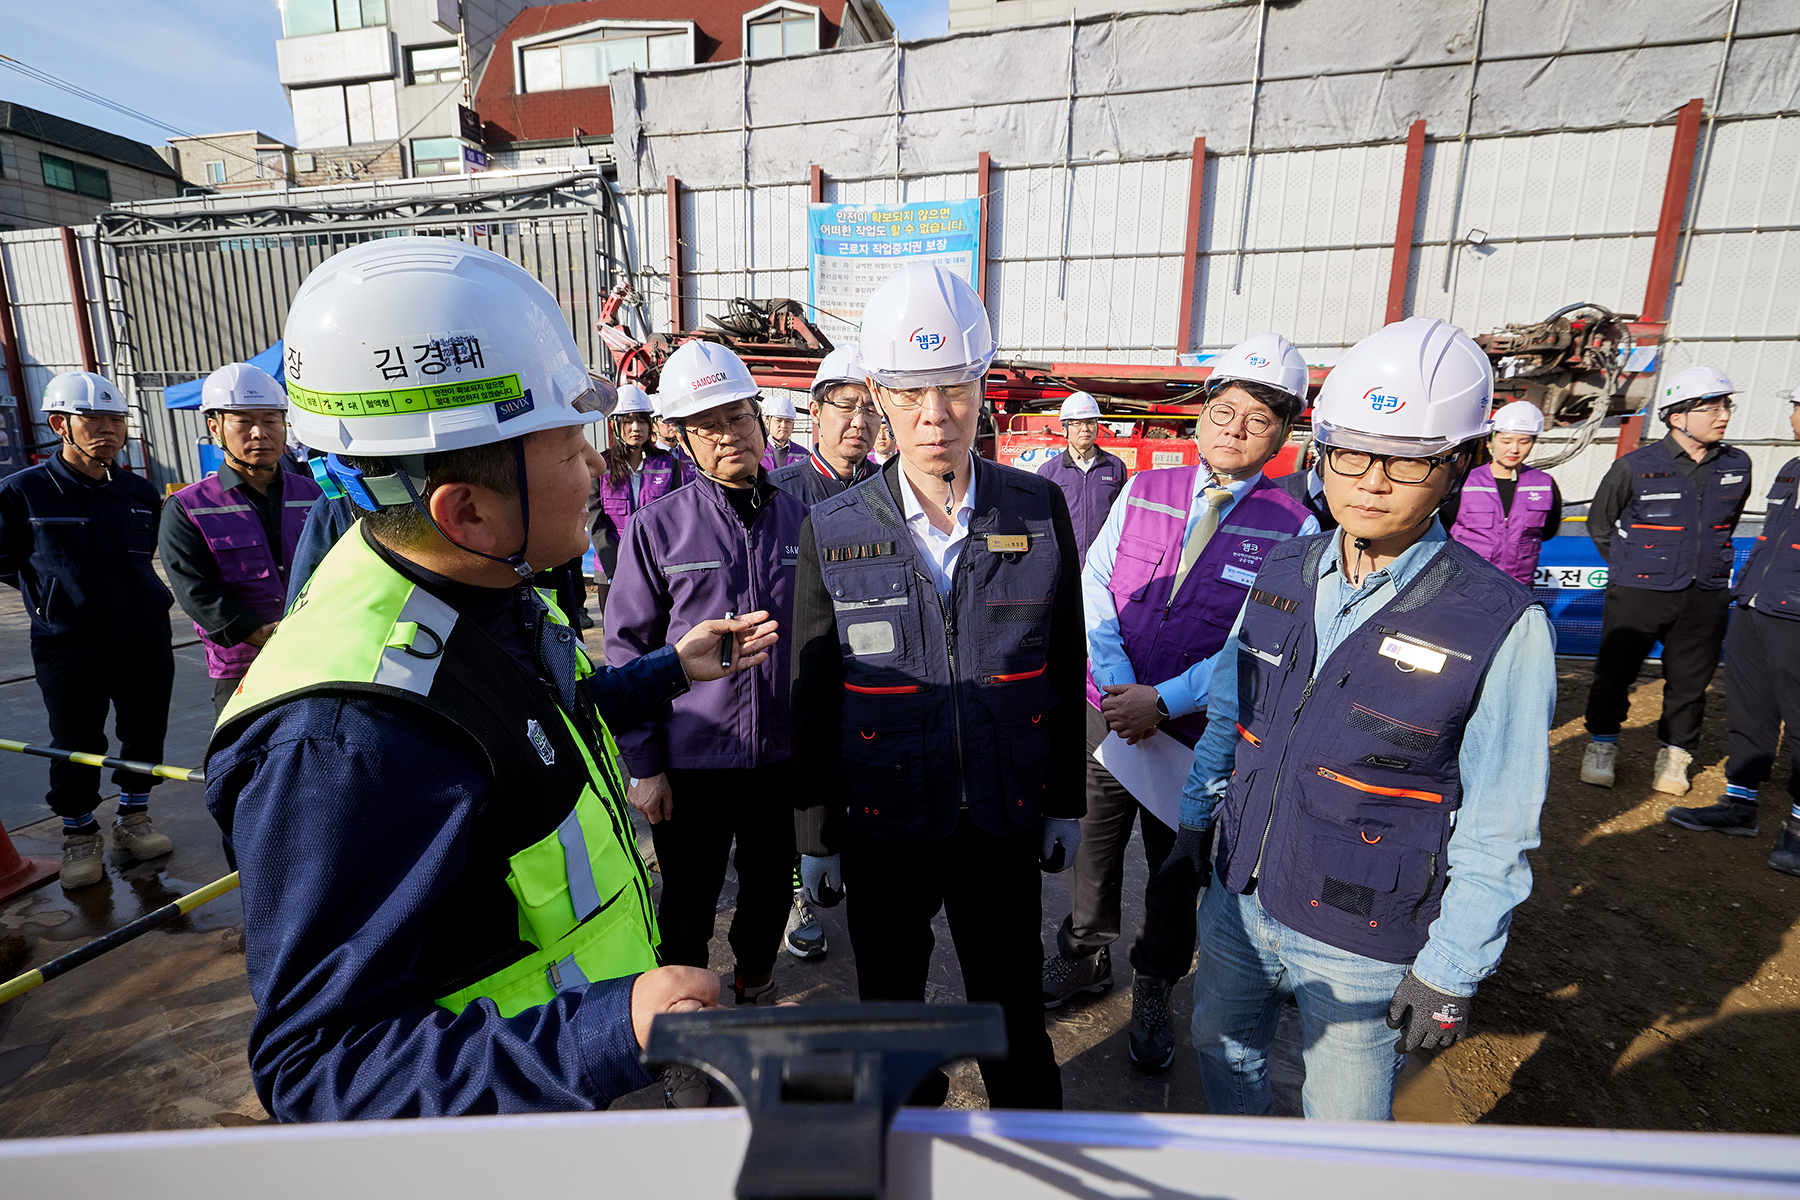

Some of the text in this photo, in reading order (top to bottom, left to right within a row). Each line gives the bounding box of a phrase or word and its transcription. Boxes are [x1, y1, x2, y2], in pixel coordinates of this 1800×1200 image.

[836, 207, 950, 223] 안전이 확보되지 않으면
[820, 219, 966, 237] 어떠한 작업도 할 수 없습니다.
[838, 238, 948, 255] 근로자 작업중지권 보장
[915, 333, 940, 350] 캠코
[286, 347, 303, 379] 장
[373, 338, 485, 380] 김경대
[1250, 356, 1267, 366] 캠코
[432, 380, 506, 397] 안전이 확보되지 않으면
[691, 372, 727, 390] SAMOOCM
[499, 396, 530, 415] SILVIX
[1370, 395, 1400, 411] 캠코
